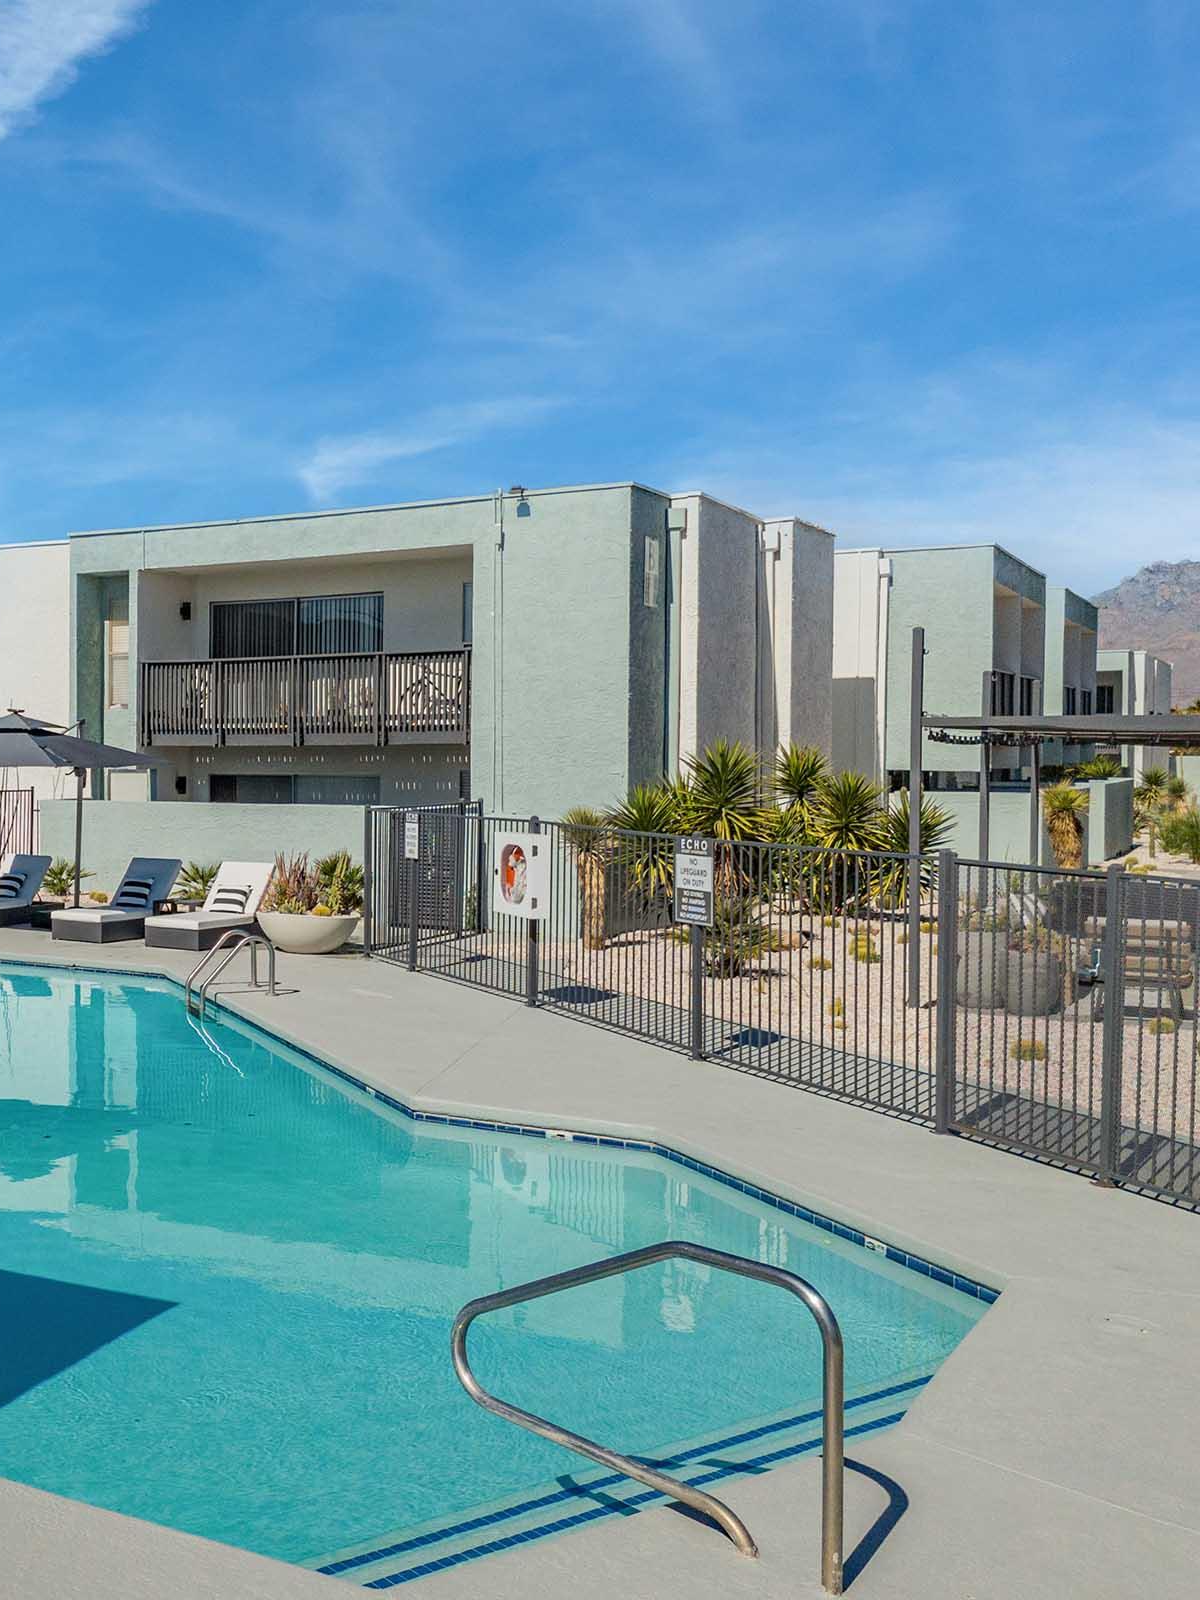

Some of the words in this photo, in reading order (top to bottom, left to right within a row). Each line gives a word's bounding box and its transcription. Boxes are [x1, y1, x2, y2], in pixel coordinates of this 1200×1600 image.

[681, 839, 707, 850] ECHO
[689, 858, 697, 866] NO
[680, 868, 707, 877] LIFEGUARD
[692, 879, 704, 888] DUTY
